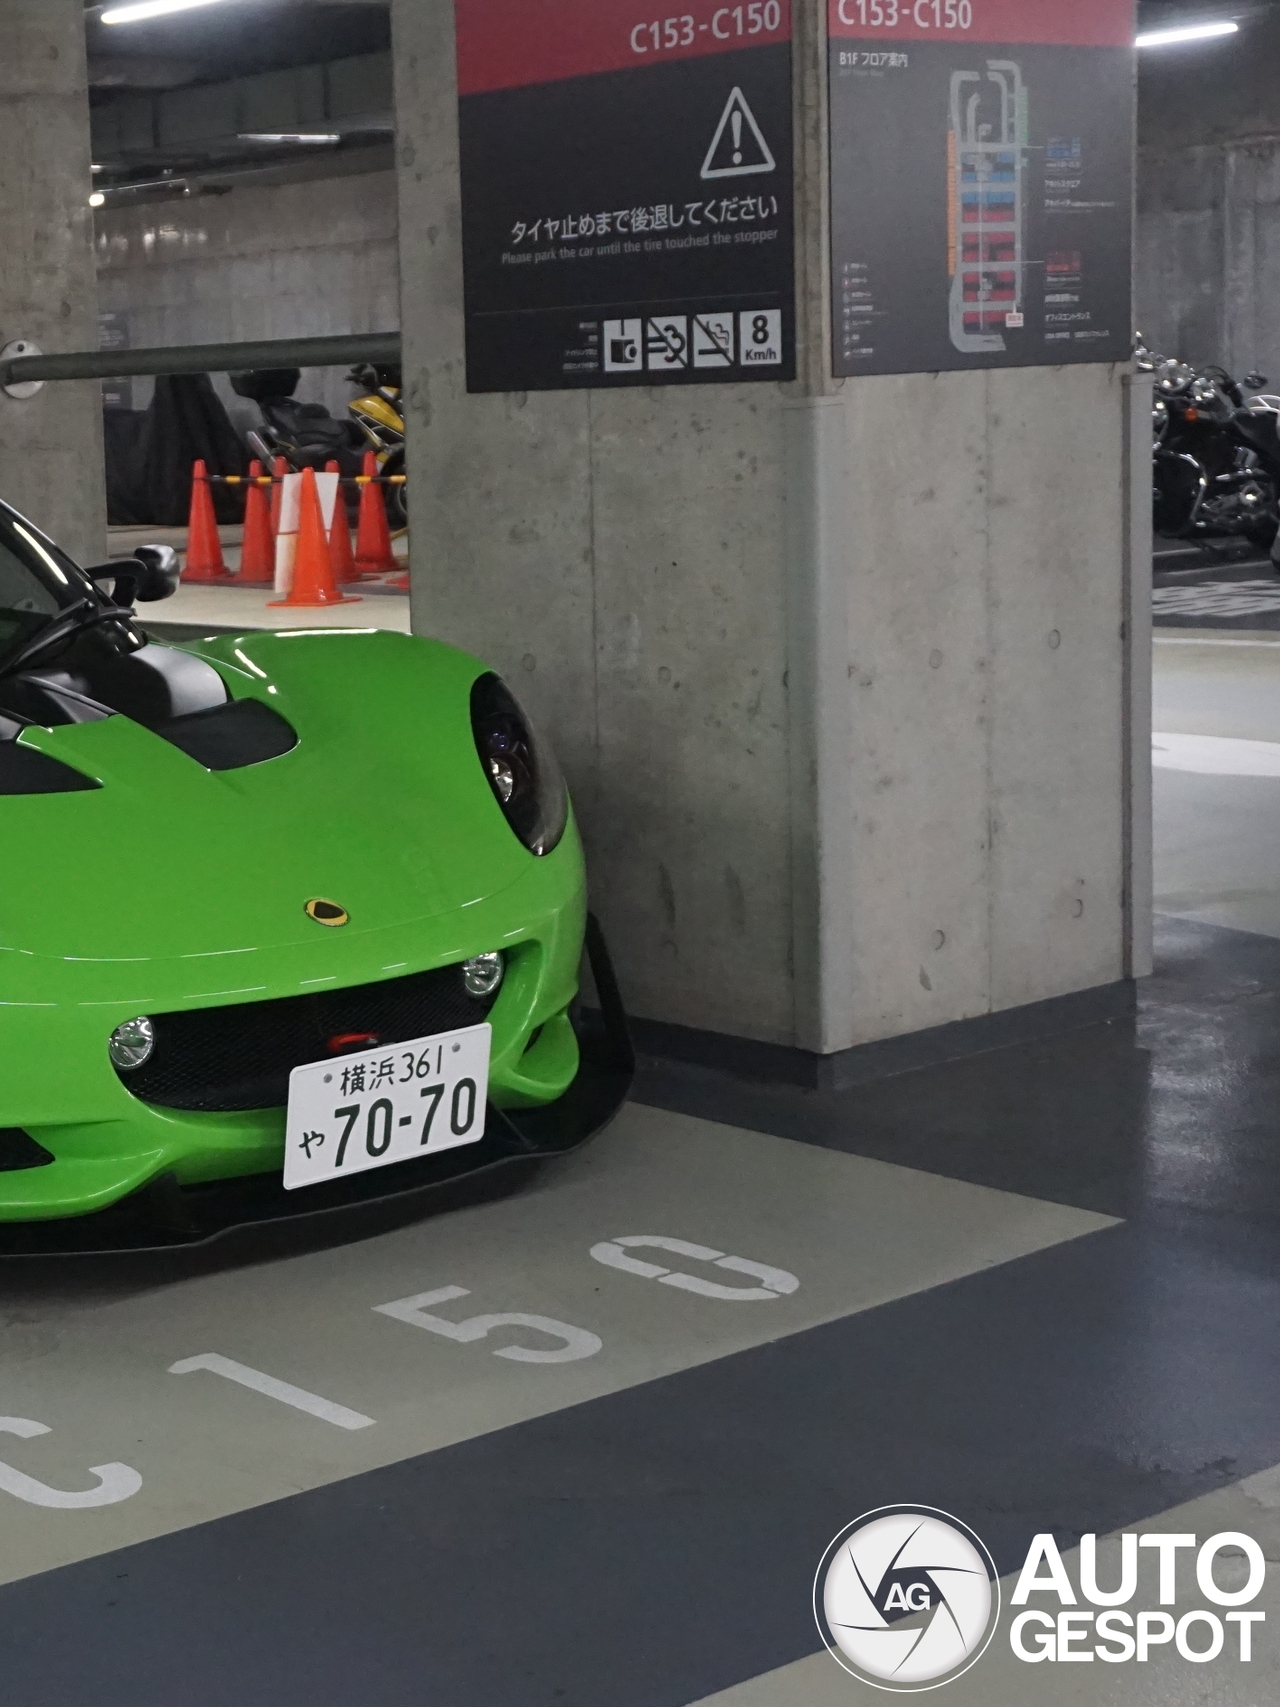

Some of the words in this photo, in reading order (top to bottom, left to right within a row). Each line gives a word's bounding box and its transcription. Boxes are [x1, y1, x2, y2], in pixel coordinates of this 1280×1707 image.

[630, 0, 781, 53] C153-C150
[837, 0, 972, 29] C153-C150
[511, 196, 778, 244] タイヤ止めまで後退してください
[502, 251, 532, 264] Please
[534, 247, 557, 263] park
[560, 246, 576, 259] the
[579, 246, 595, 257] car
[597, 242, 620, 255] until
[623, 240, 640, 253] the
[643, 238, 662, 251] tire
[665, 233, 710, 249] touched
[713, 231, 731, 244] the
[734, 229, 779, 244] stopper
[752, 314, 770, 344] 8
[745, 347, 777, 361] Km/h
[298, 1130, 325, 1159] や
[333, 1077, 477, 1168] 70-70
